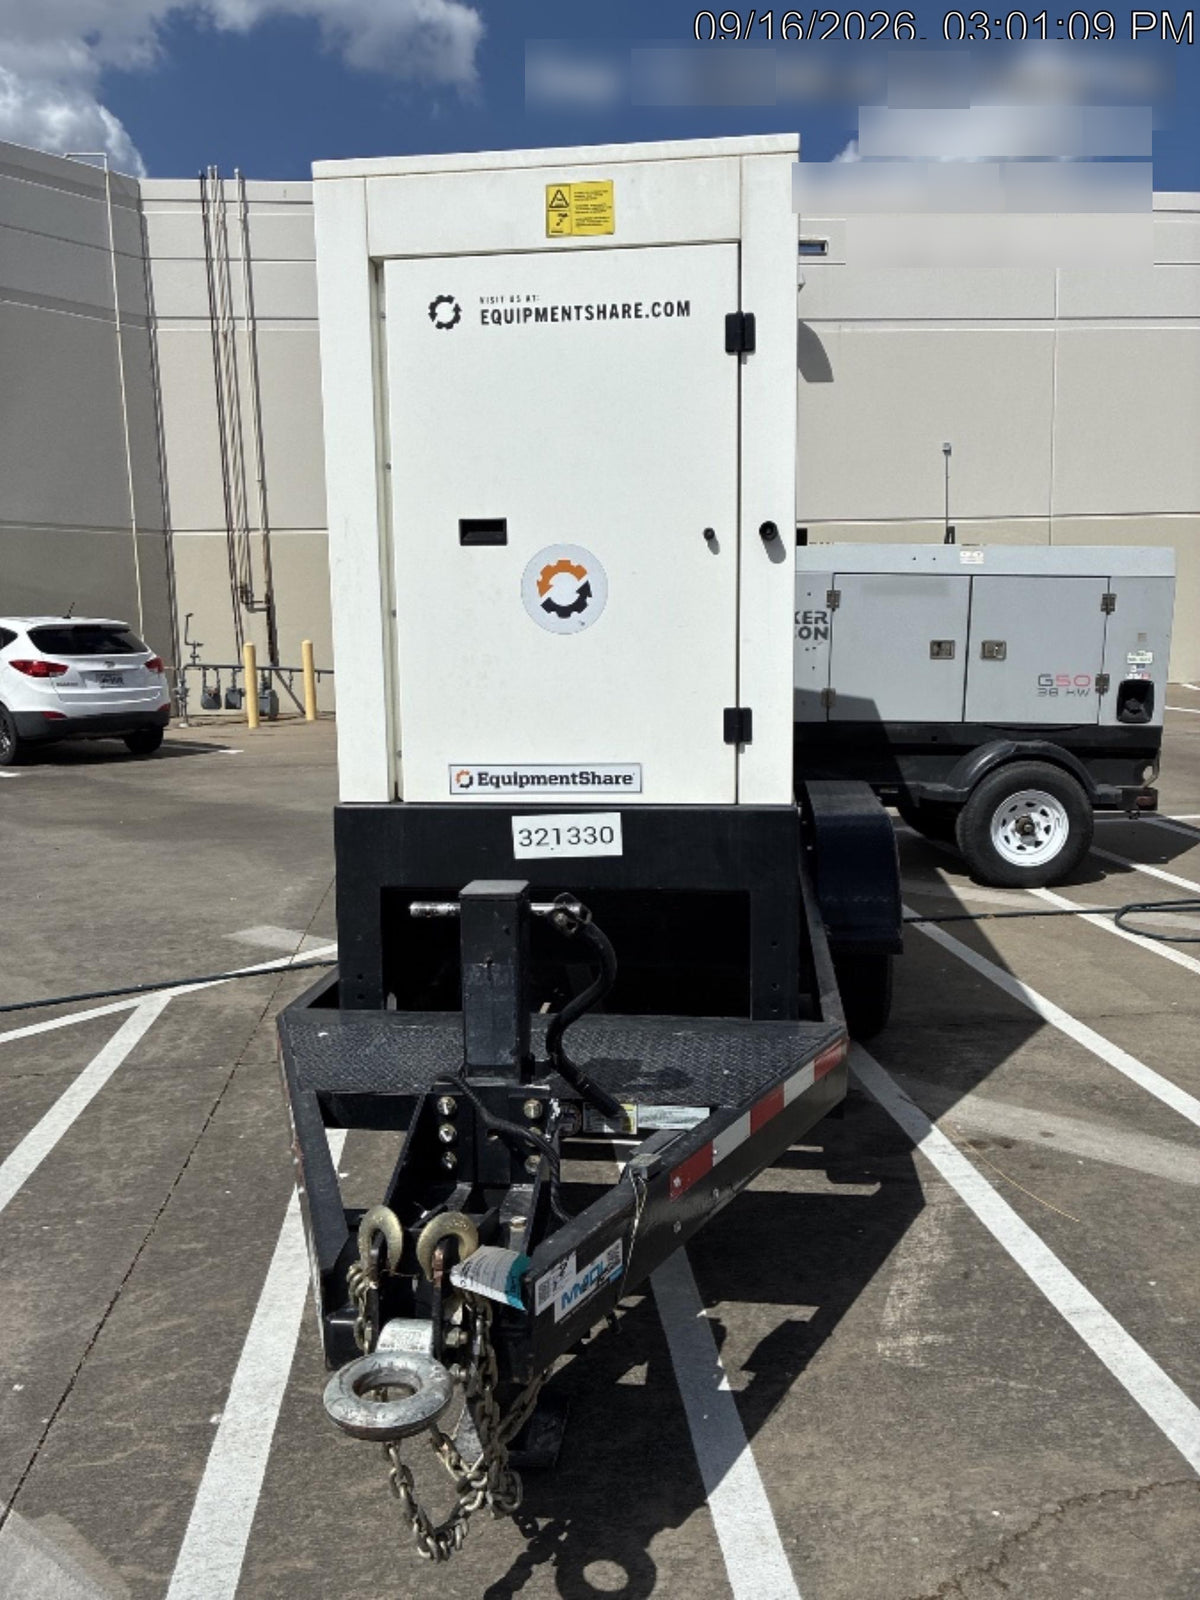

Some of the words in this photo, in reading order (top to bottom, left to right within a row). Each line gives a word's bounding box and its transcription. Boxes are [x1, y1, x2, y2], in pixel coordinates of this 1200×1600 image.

[479, 296, 504, 304] VISIT
[510, 295, 521, 303] US
[480, 300, 691, 326] EQUIPMENTSHARE.COM
[1037, 674, 1091, 687] G50
[1037, 687, 1059, 697] 38
[477, 771, 633, 788] EquipmentShare
[518, 826, 615, 847] 321330
